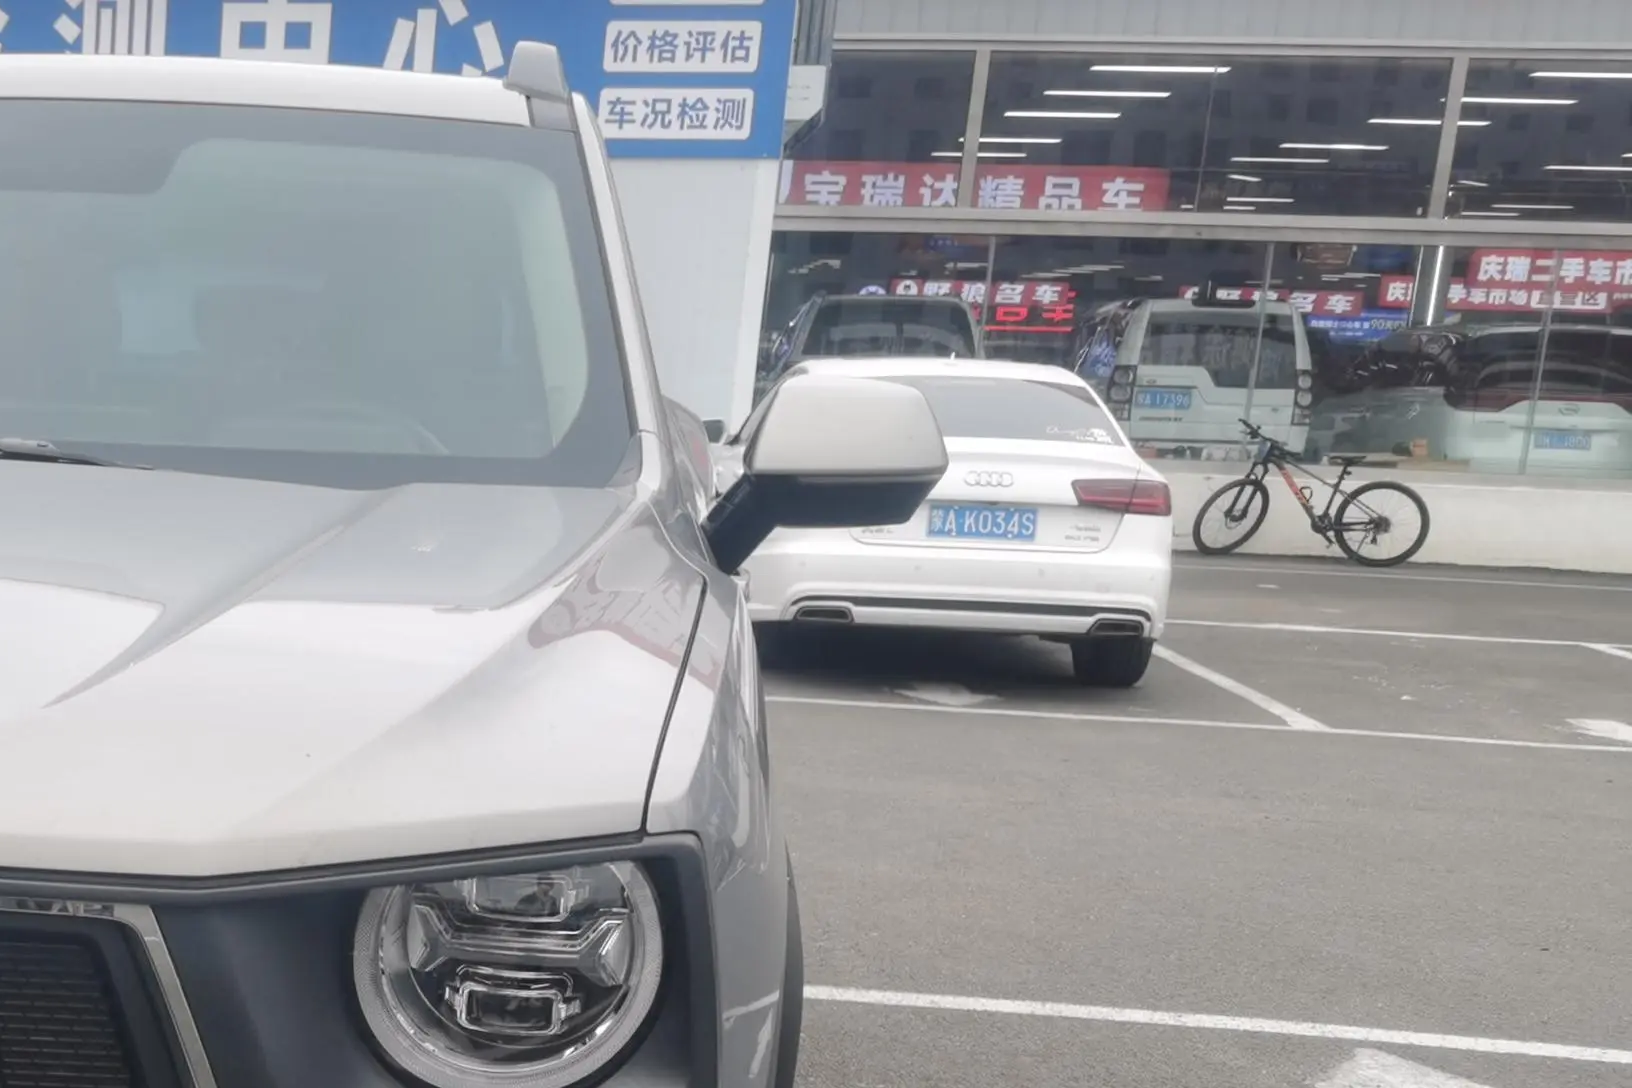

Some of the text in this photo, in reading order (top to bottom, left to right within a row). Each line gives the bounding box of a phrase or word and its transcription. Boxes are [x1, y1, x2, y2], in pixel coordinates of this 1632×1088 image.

[610, 30, 754, 64] 价格评估
[604, 97, 748, 131] 车况检测
